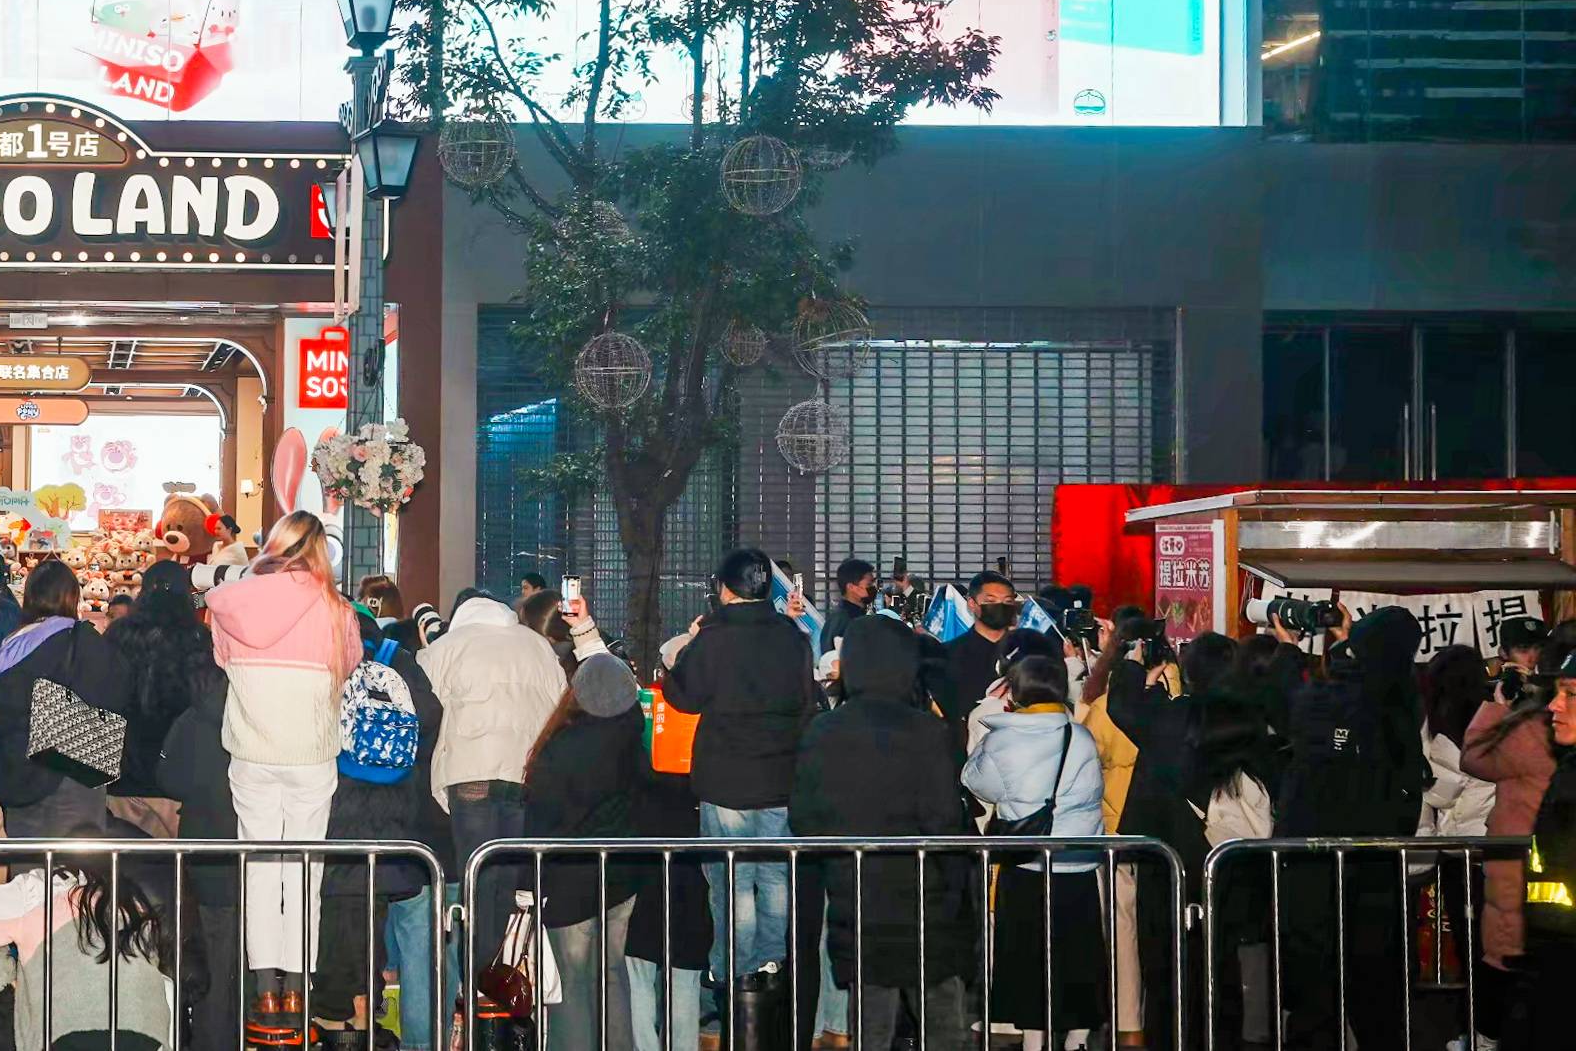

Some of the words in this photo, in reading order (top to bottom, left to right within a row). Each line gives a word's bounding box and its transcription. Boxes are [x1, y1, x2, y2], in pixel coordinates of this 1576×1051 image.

[98, 65, 175, 103] LAND
[71, 172, 280, 241] LAND
[306, 350, 349, 372] MIN
[1159, 559, 1210, 590] 提拉米苏
